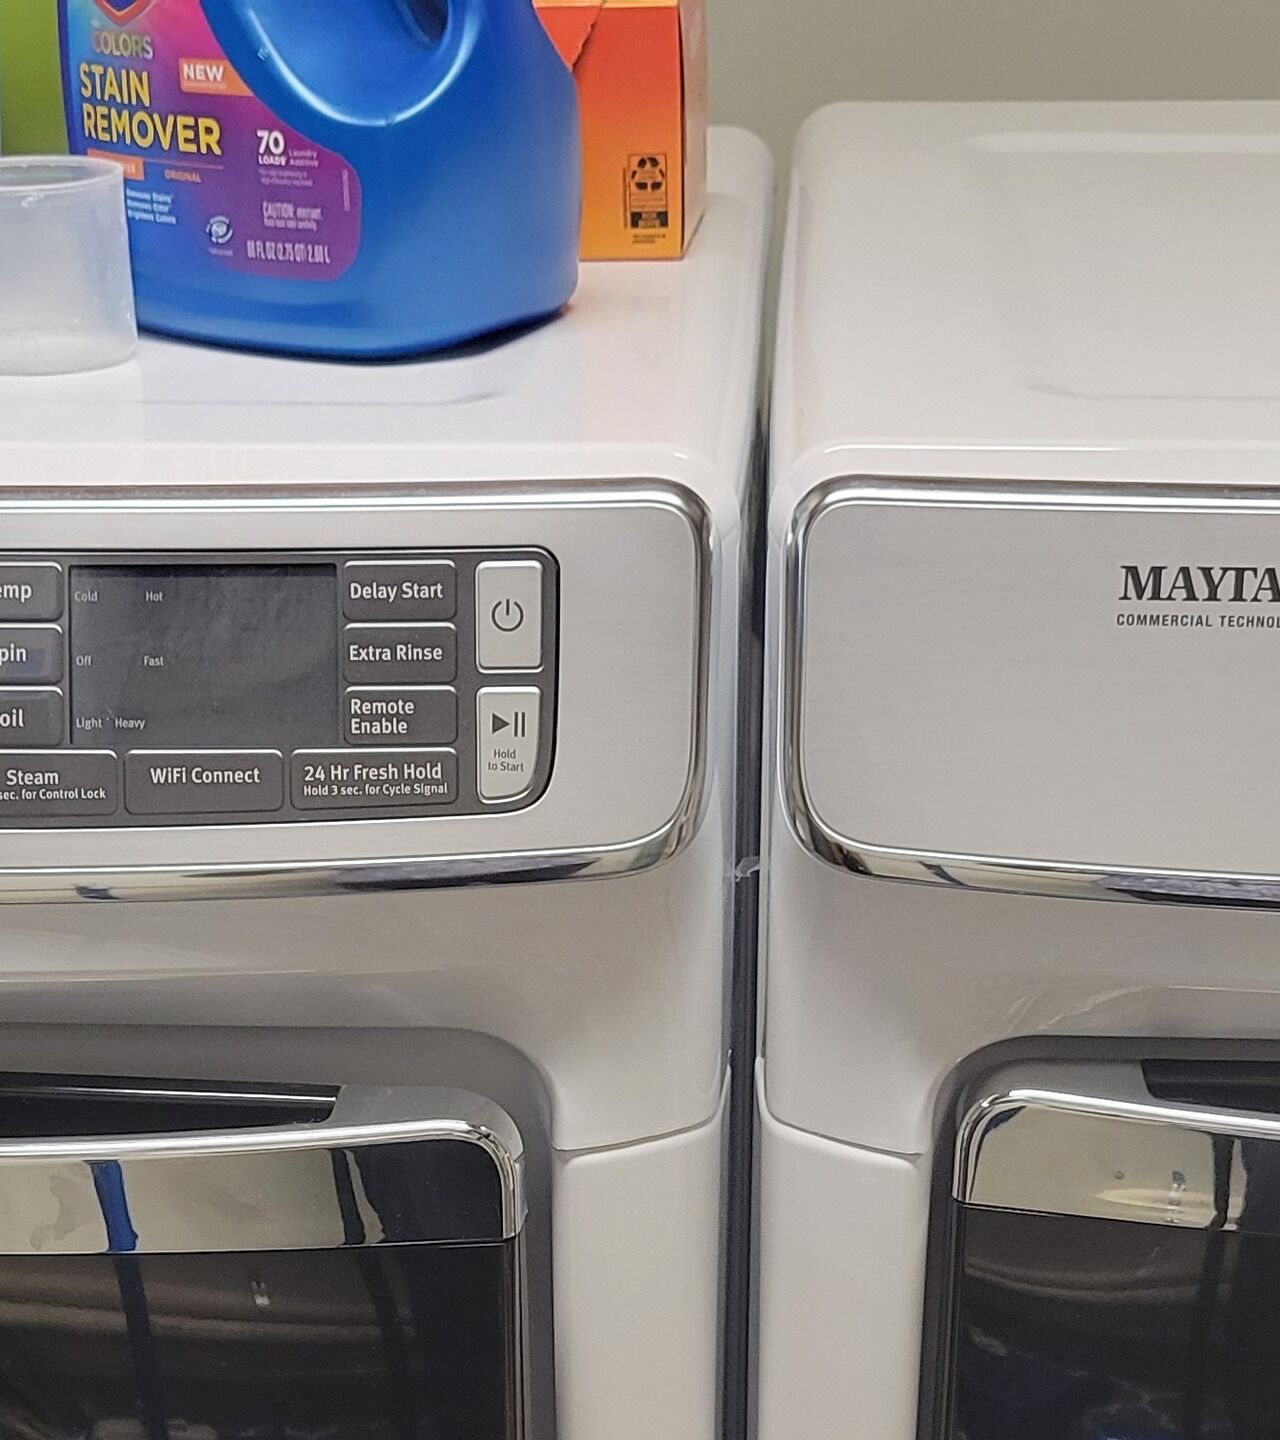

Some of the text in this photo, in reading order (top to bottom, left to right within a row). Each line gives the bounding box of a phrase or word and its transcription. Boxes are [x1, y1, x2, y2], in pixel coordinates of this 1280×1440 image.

[92, 30, 153, 60] COLORS
[182, 63, 224, 82] NEW
[80, 62, 150, 107] STAIN
[82, 103, 222, 155] REMOVER
[256, 129, 285, 155] 70
[74, 591, 98, 602] Cold
[145, 591, 163, 602] Hot
[350, 582, 443, 602] Delay Start
[1116, 613, 1213, 627] COMMERCIAL
[349, 644, 443, 661] Extra Rinse
[76, 655, 92, 667] Off
[143, 655, 164, 667] Fast
[350, 699, 414, 715] Remote
[75, 718, 103, 729] Light
[114, 718, 146, 730] Heavy
[351, 718, 408, 735] Enable
[493, 748, 516, 759] Hold
[304, 762, 442, 782] 24 Hr Fresh Hold
[488, 761, 524, 772] to Start
[6, 769, 59, 785] Steam
[150, 767, 260, 784] WiFi Connect
[21, 788, 36, 800] for
[39, 788, 78, 800] Control
[81, 787, 106, 799] Lock
[303, 783, 448, 797] Hold sec. for Cycle Signal
